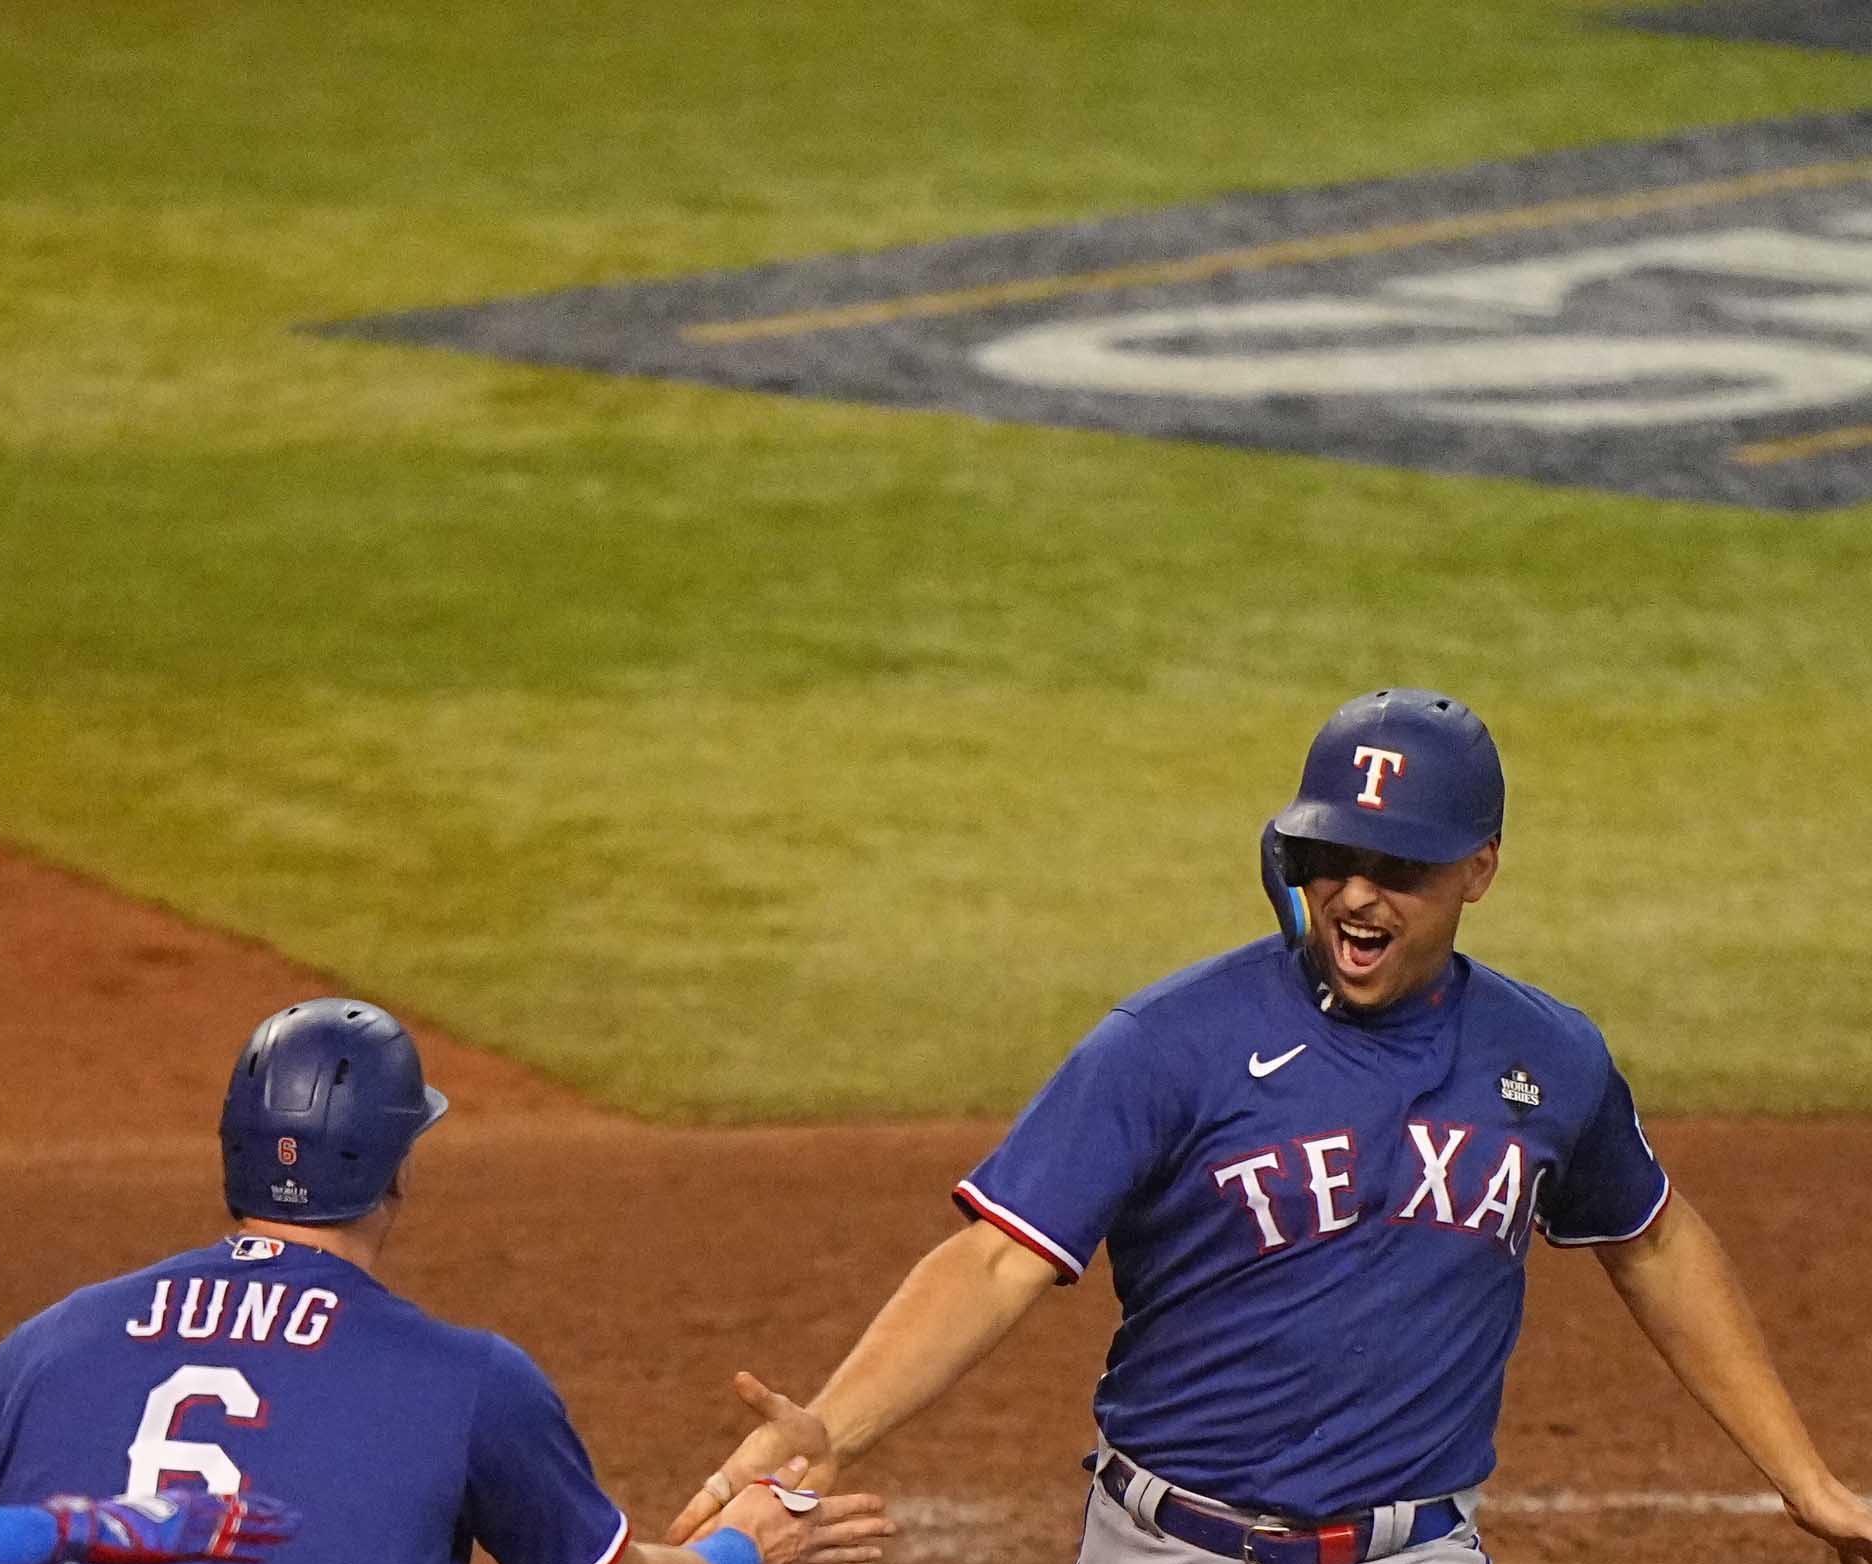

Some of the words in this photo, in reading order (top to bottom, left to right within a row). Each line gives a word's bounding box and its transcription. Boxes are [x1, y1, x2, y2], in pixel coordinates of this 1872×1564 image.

[1353, 745, 1406, 810] T
[1500, 1077, 1540, 1096] WORLD
[1501, 1088, 1540, 1106] SERIES
[278, 1137, 298, 1165] 6
[125, 1277, 340, 1349] JUNG
[127, 1364, 266, 1501] 6
